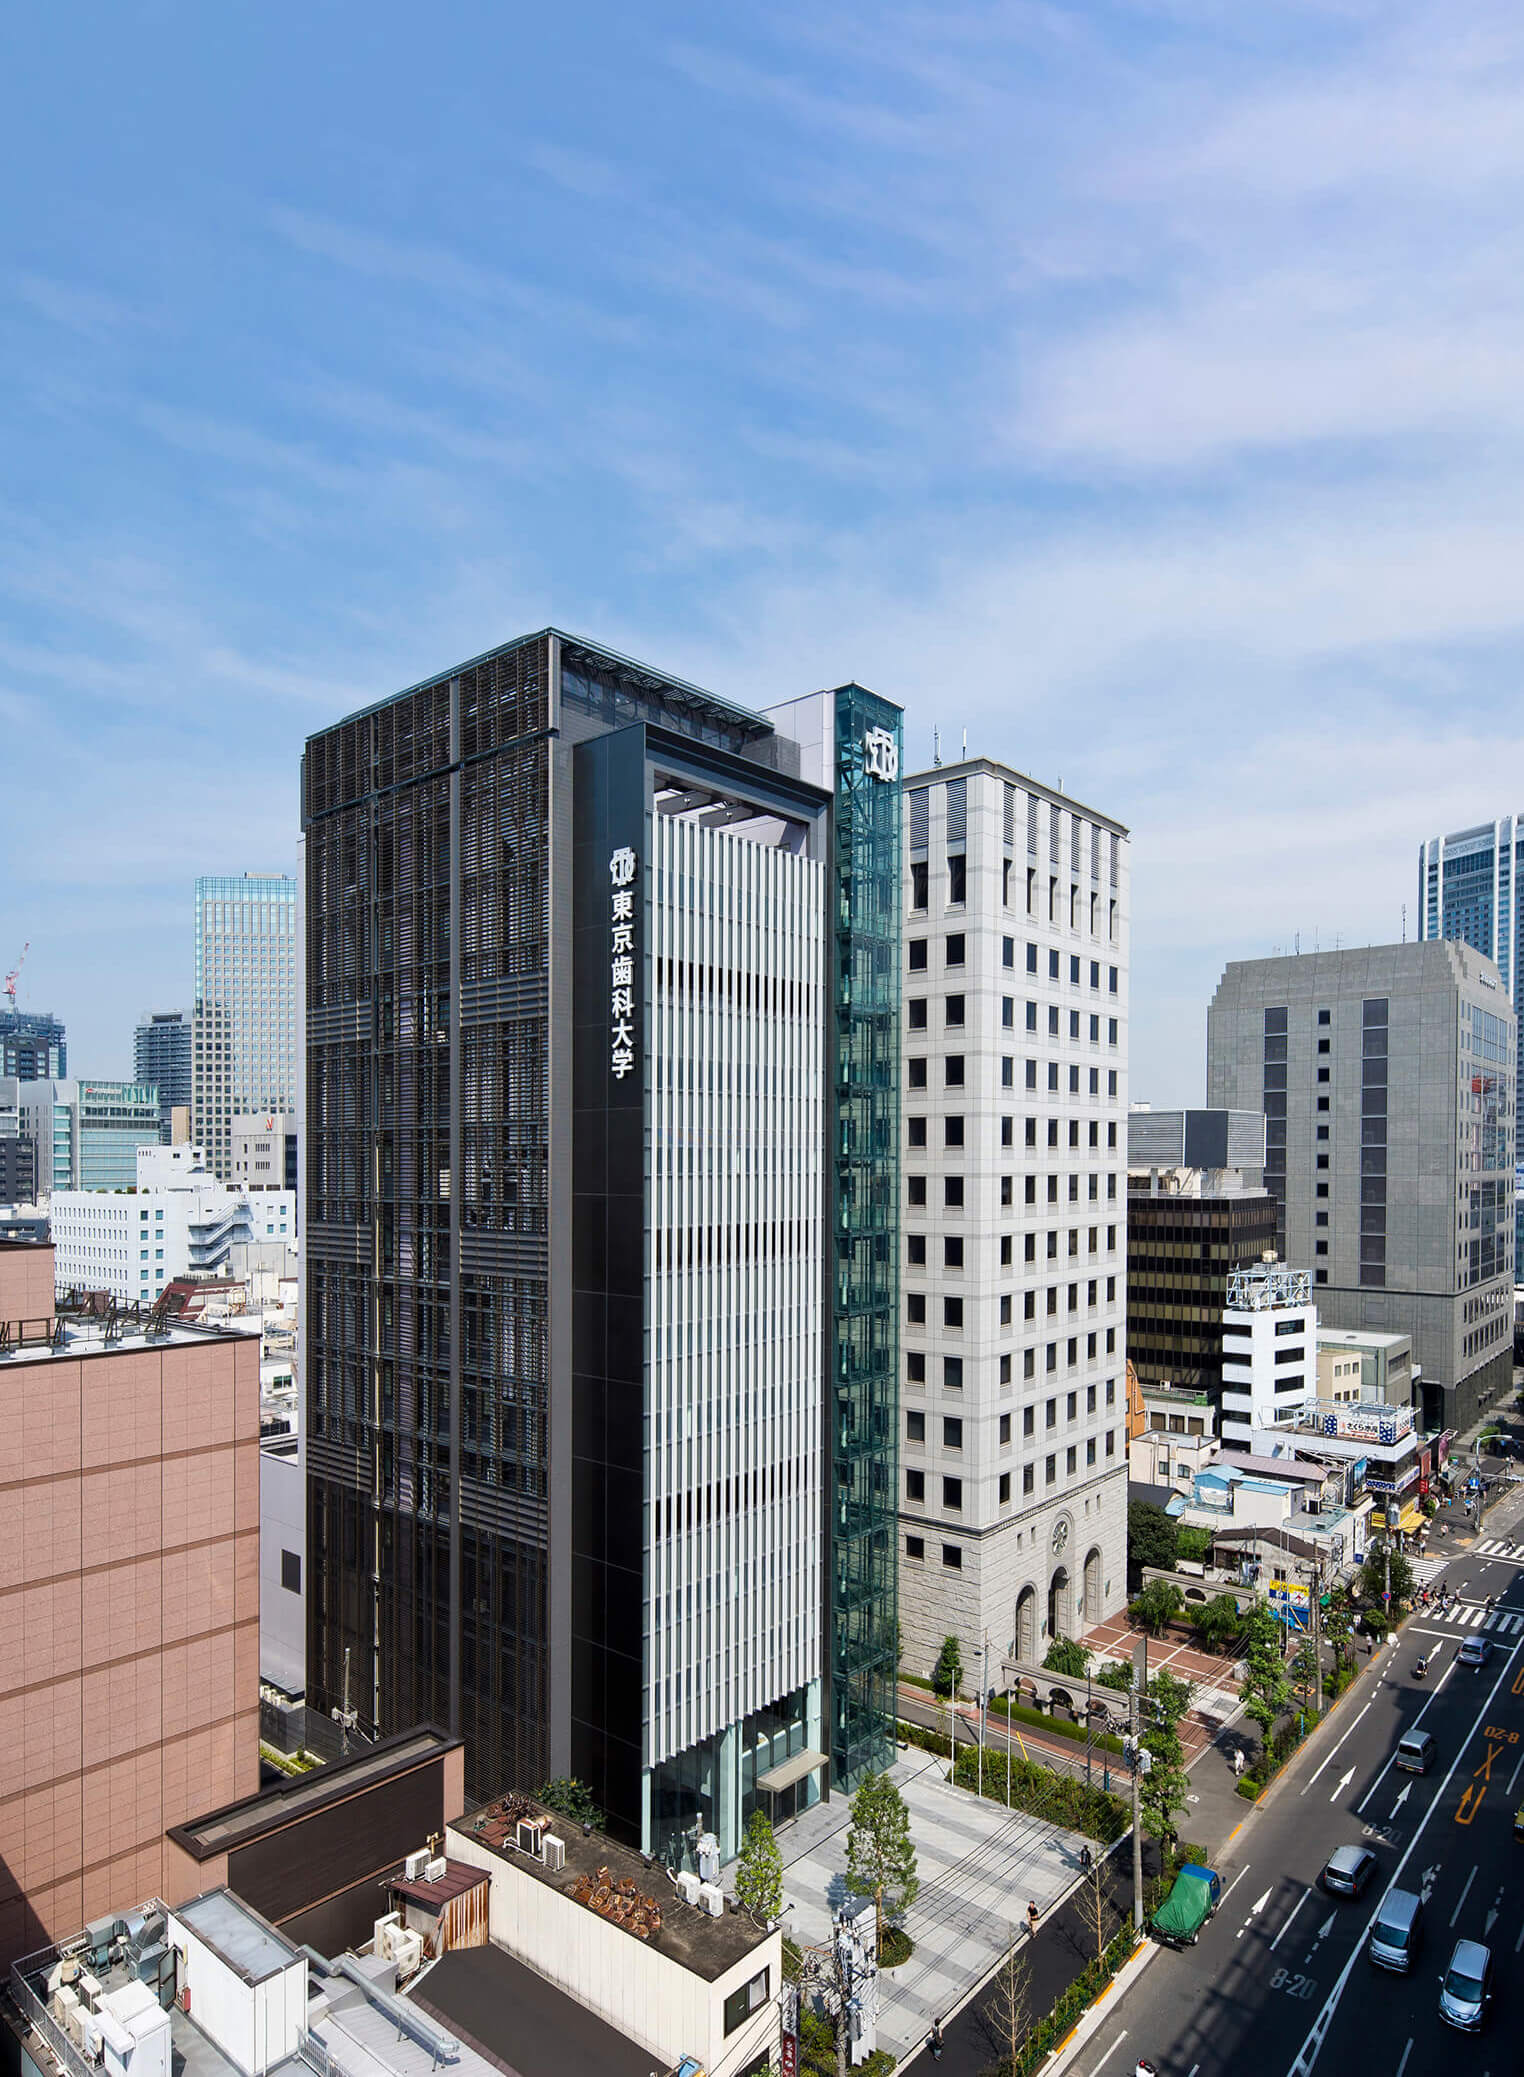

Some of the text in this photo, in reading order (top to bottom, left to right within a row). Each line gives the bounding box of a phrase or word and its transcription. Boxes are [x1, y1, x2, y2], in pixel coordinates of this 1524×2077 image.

[611, 890, 636, 1079] 東京歯科大学
[1270, 1968, 1319, 2000] 8-20
